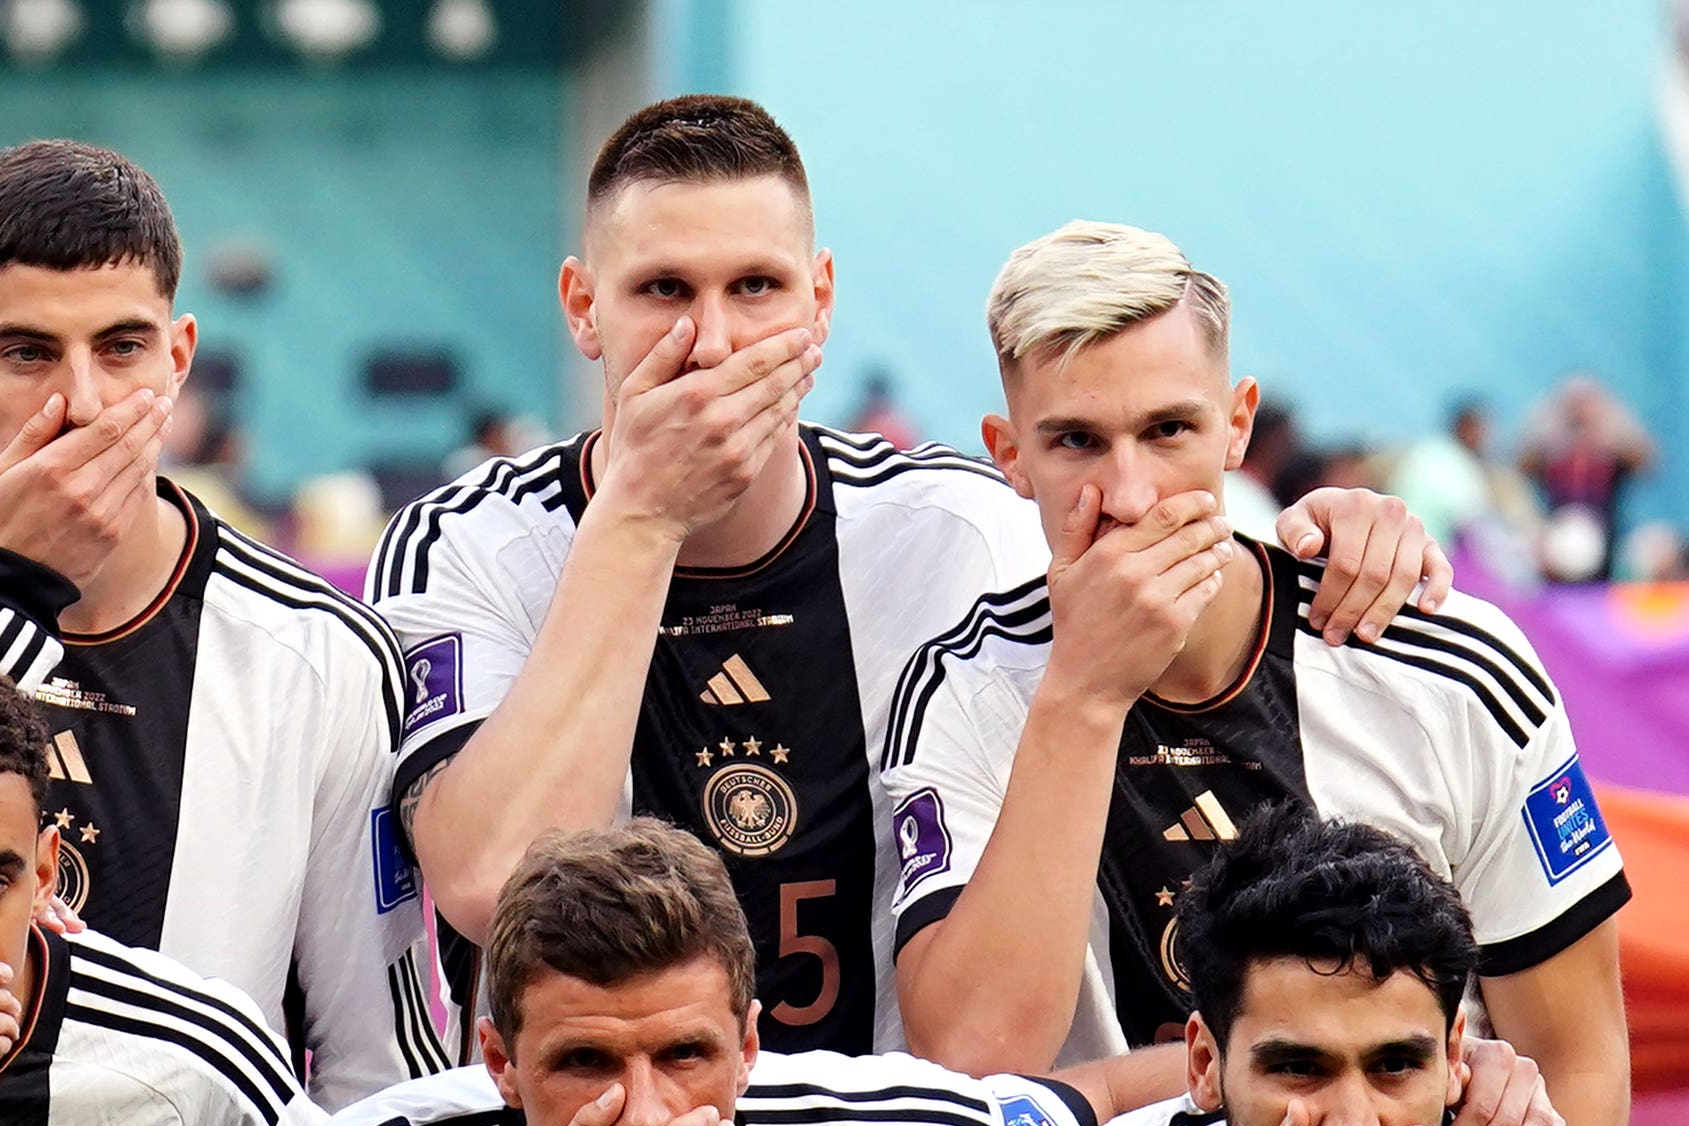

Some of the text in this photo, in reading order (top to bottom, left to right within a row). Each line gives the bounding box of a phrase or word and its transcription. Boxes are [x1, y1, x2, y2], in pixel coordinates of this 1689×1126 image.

[682, 608, 762, 626] 23 NOVEMBER 2022
[710, 604, 737, 614] JAPAN
[691, 619, 756, 635] INTERNATIONAL
[83, 691, 107, 702] 2022
[98, 702, 137, 716] STADIUM
[719, 775, 772, 794] DEUTSCHER
[1553, 798, 1584, 828] FOOTBALL
[1557, 807, 1590, 841] UNITES
[769, 878, 842, 1027] 5
